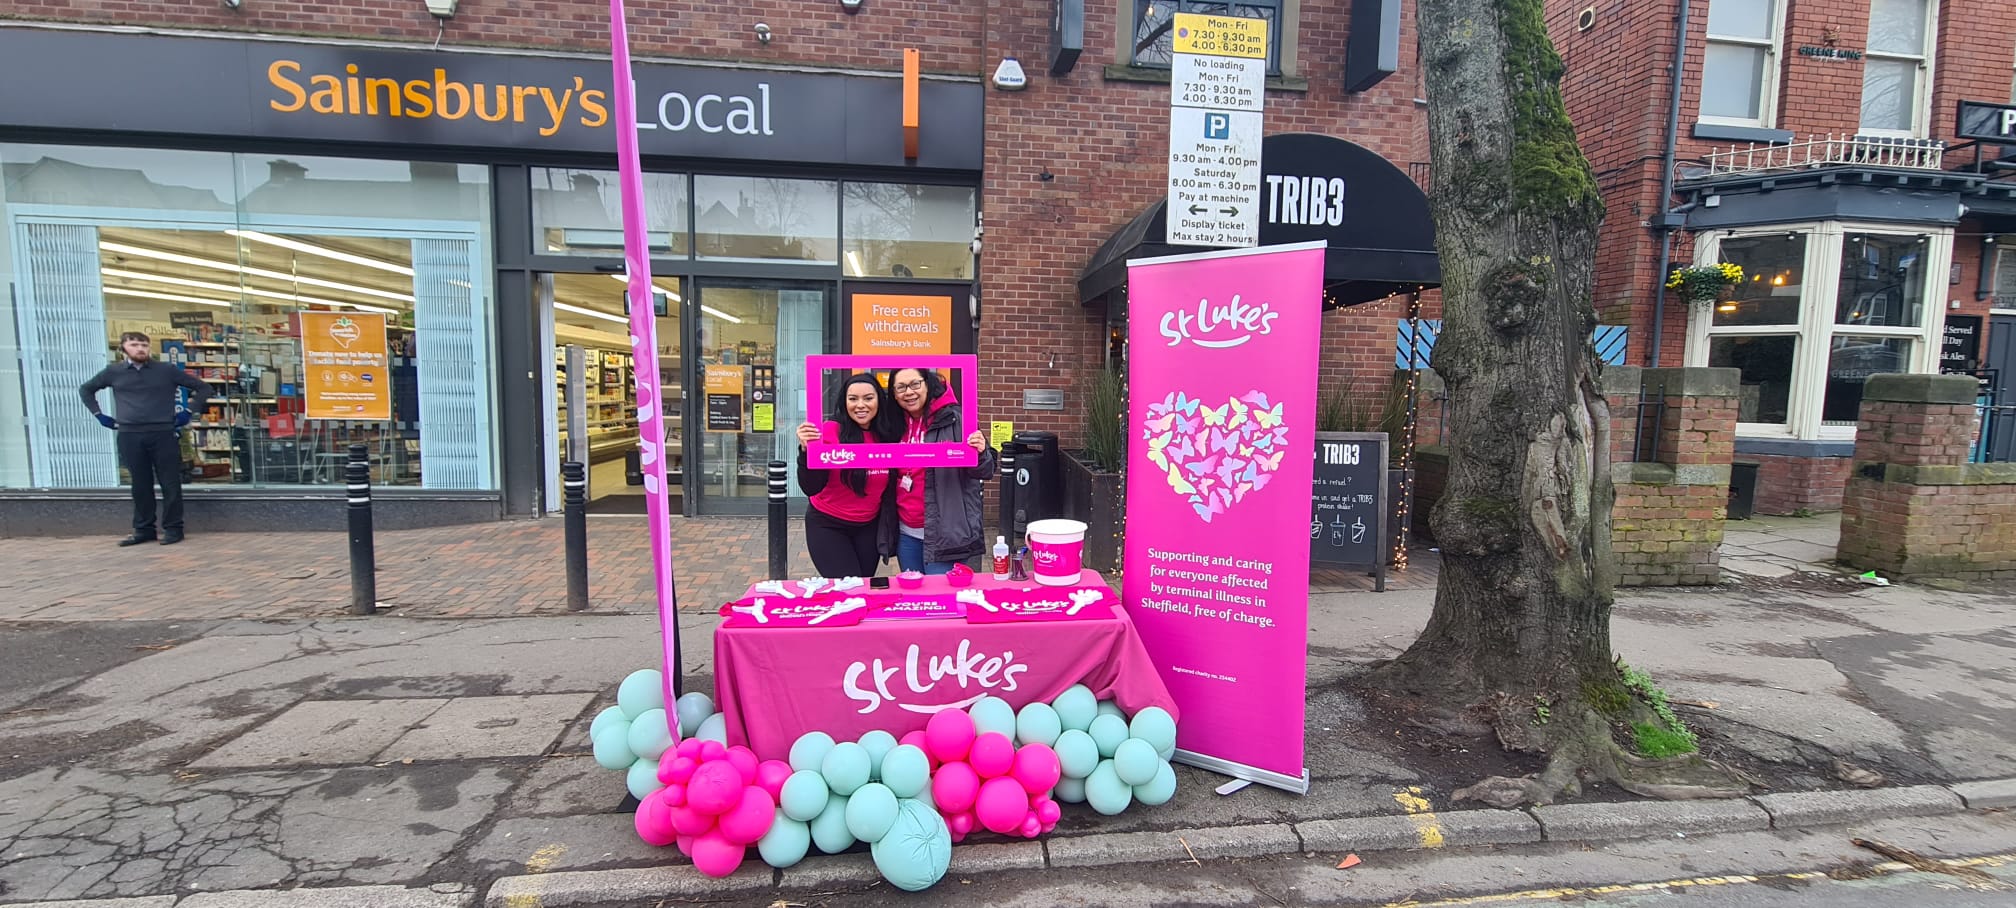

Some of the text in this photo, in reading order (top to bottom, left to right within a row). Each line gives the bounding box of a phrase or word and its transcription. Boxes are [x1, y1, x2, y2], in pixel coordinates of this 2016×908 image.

[1208, 19, 1228, 29] Mon
[1236, 22, 1248, 30] Fri
[1193, 29, 1215, 39] 7.30
[1222, 32, 1245, 41] 9.30
[1247, 35, 1261, 43] am
[1191, 40, 1215, 50] 4.00
[1223, 43, 1245, 52] 6.30
[1247, 46, 1262, 54] pm
[1799, 46, 1837, 57] GREENE
[1194, 58, 1245, 71] No loading
[1198, 72, 1219, 81] Mon
[1226, 74, 1239, 83] Fri
[1184, 82, 1206, 92] 7.30
[1213, 85, 1236, 94] 9.30
[1238, 88, 1252, 96] am
[267, 59, 774, 136] Sainsbury's Local
[1183, 93, 1207, 103] 4.00
[1214, 95, 1236, 105] 6.30
[1238, 98, 1252, 107] pm
[1210, 115, 1226, 137] P
[1196, 143, 1216, 153] Mon
[1224, 144, 1236, 154] Fri
[1172, 153, 1195, 163] 9.30
[1197, 156, 1211, 164] am
[1218, 156, 1241, 166] 4.00
[1243, 159, 1258, 168] pm
[1194, 168, 1237, 179] Saturday
[1172, 178, 1195, 188] 8.00
[1197, 181, 1211, 189] am
[1218, 181, 1241, 191] 6.30
[1242, 183, 1257, 192] pm
[1178, 191, 1250, 204] Pay at machine
[1266, 174, 1345, 227] TRIB3
[1181, 219, 1245, 231] Display ticket
[1172, 231, 1253, 244] Max stay 2 hours
[871, 304, 931, 318] Free cash
[863, 320, 939, 333] withdrawals
[1159, 294, 1279, 347] St Luke's
[1948, 325, 1973, 335] Served
[870, 338, 931, 349] Sainsbury's Bank
[1949, 336, 1963, 346] Day
[1949, 352, 1966, 361] Ales
[820, 448, 856, 464] St Luke's
[1322, 443, 1360, 465] TRIB3
[1147, 547, 1273, 575] Supporting and caring
[1150, 564, 1268, 590] for everyone affected
[1150, 581, 1266, 608] by terminal illness in
[1141, 597, 1276, 628] Sheffield, free of charge.
[842, 638, 1028, 715] St Luke's
